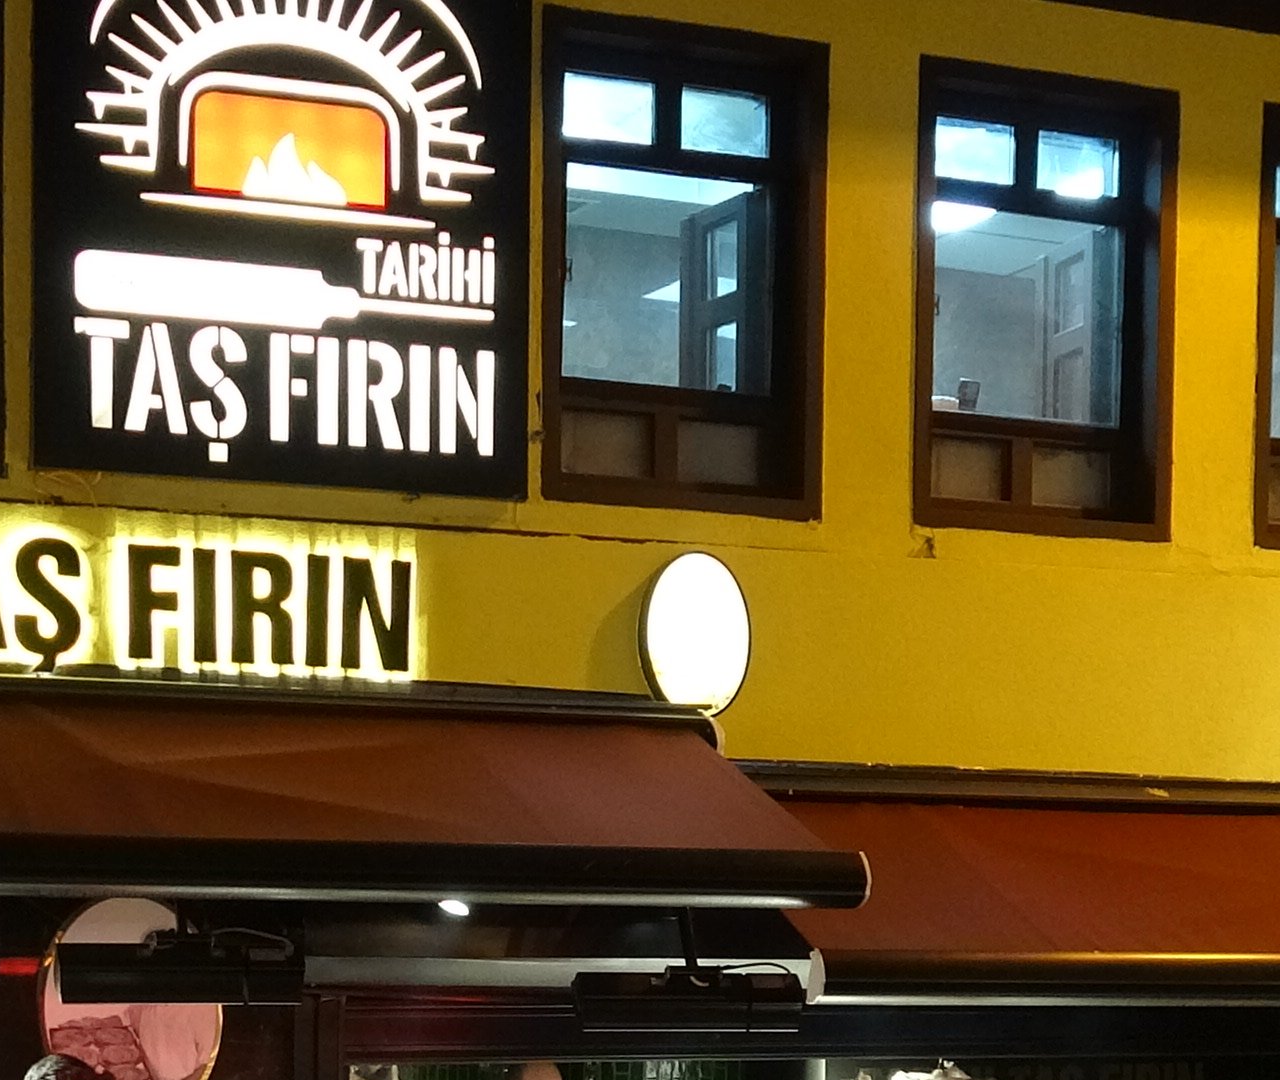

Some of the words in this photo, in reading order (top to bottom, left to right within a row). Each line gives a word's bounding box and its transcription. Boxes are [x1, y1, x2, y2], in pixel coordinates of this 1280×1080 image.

[355, 231, 495, 304] TARİHİ
[74, 316, 248, 462] TAŞ
[269, 332, 495, 457] FIRIN
[125, 543, 412, 671] FIRIN
